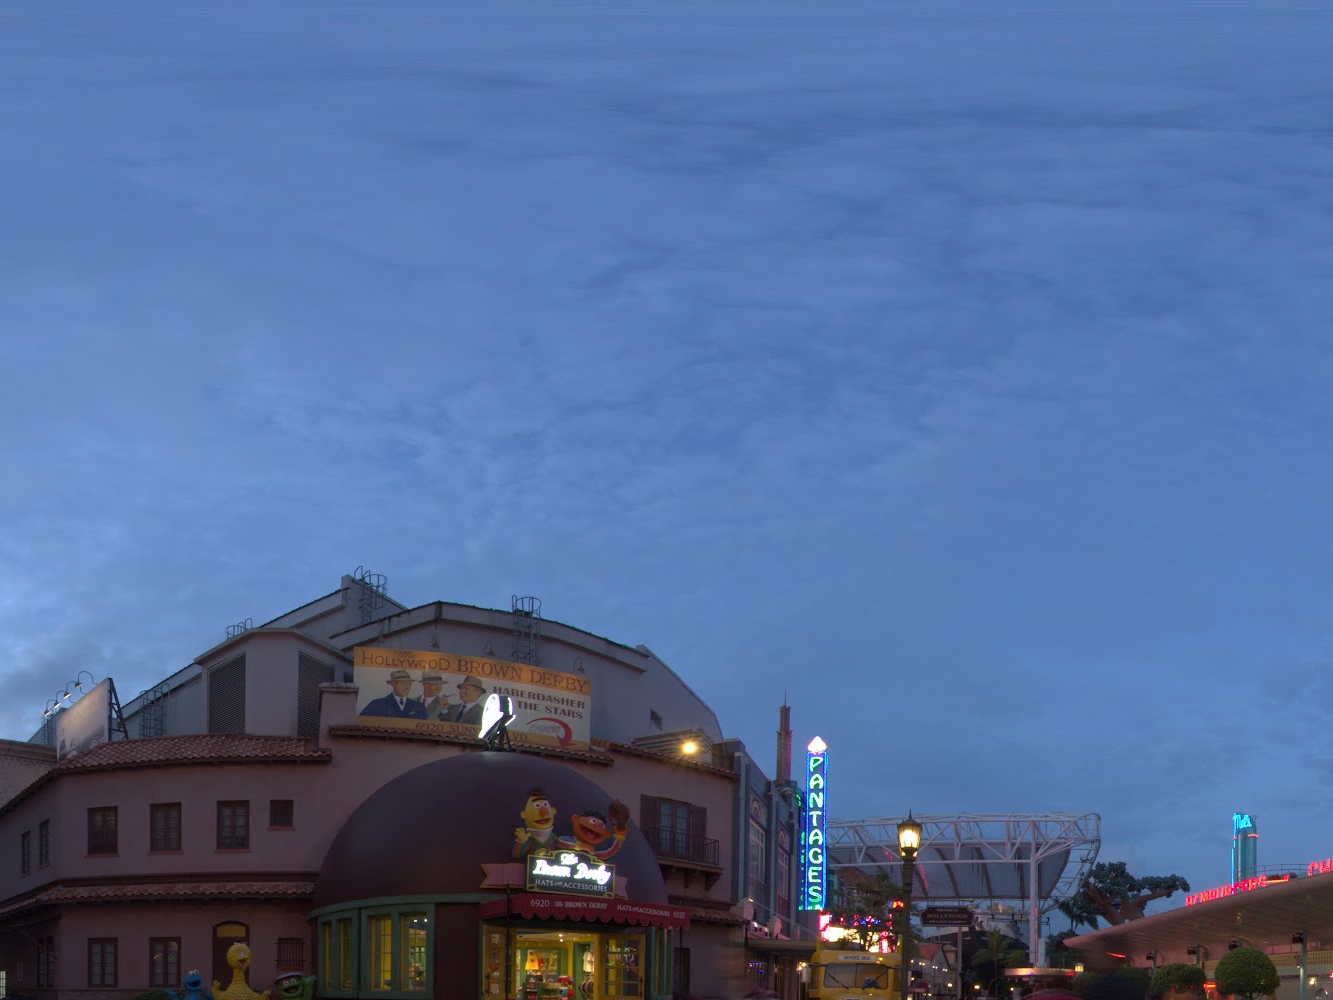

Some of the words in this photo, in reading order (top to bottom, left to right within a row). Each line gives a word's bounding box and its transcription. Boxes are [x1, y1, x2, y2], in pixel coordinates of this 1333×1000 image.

[362, 650, 450, 670] HOLLYWOOD
[457, 657, 523, 681] BROWN
[530, 669, 589, 693] DERBY
[493, 686, 585, 709] HABERDASHER
[517, 701, 543, 712] THE
[545, 706, 583, 719] STARS
[415, 721, 444, 732] 6920
[450, 724, 479, 737] SUNS
[808, 756, 824, 903] PANTAGES
[535, 878, 553, 887] HATS
[563, 882, 608, 893] ACCESSORIES
[530, 900, 550, 908] 6920
